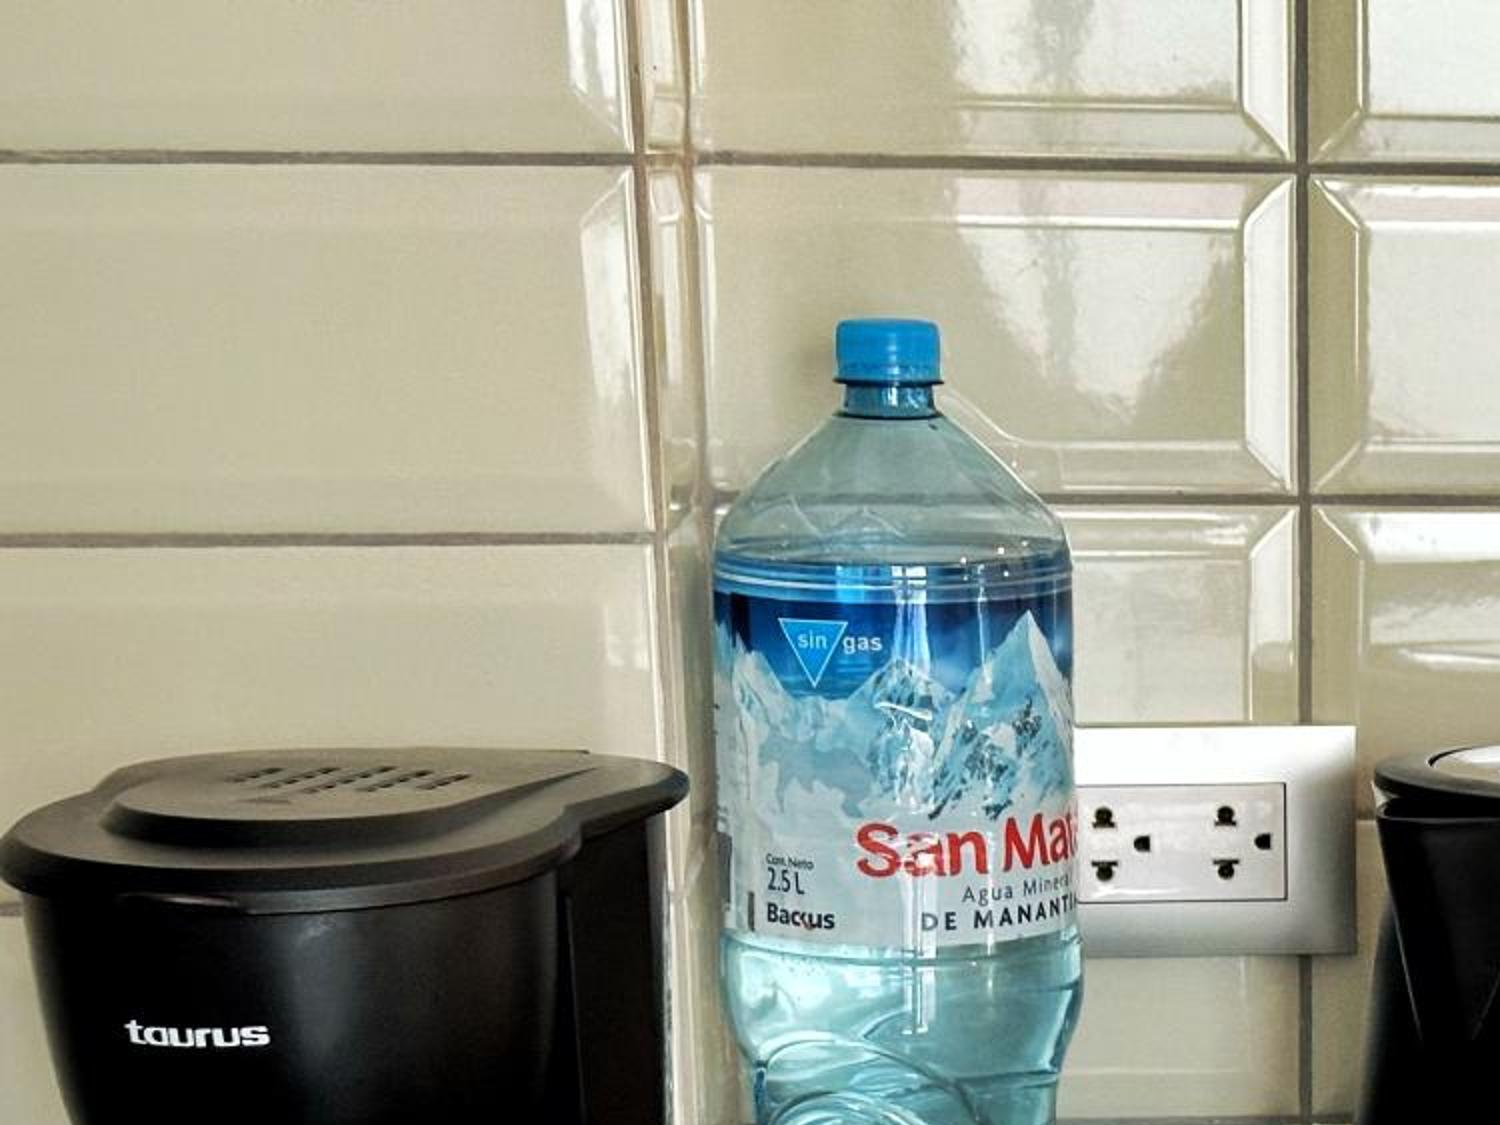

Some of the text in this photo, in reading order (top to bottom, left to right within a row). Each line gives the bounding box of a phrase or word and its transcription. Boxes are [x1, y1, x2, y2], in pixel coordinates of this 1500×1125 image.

[797, 630, 882, 655] sin gas
[856, 822, 988, 878] San
[962, 884, 1014, 907] Agua
[921, 911, 957, 931] DE
[123, 1019, 271, 1048] taurus
